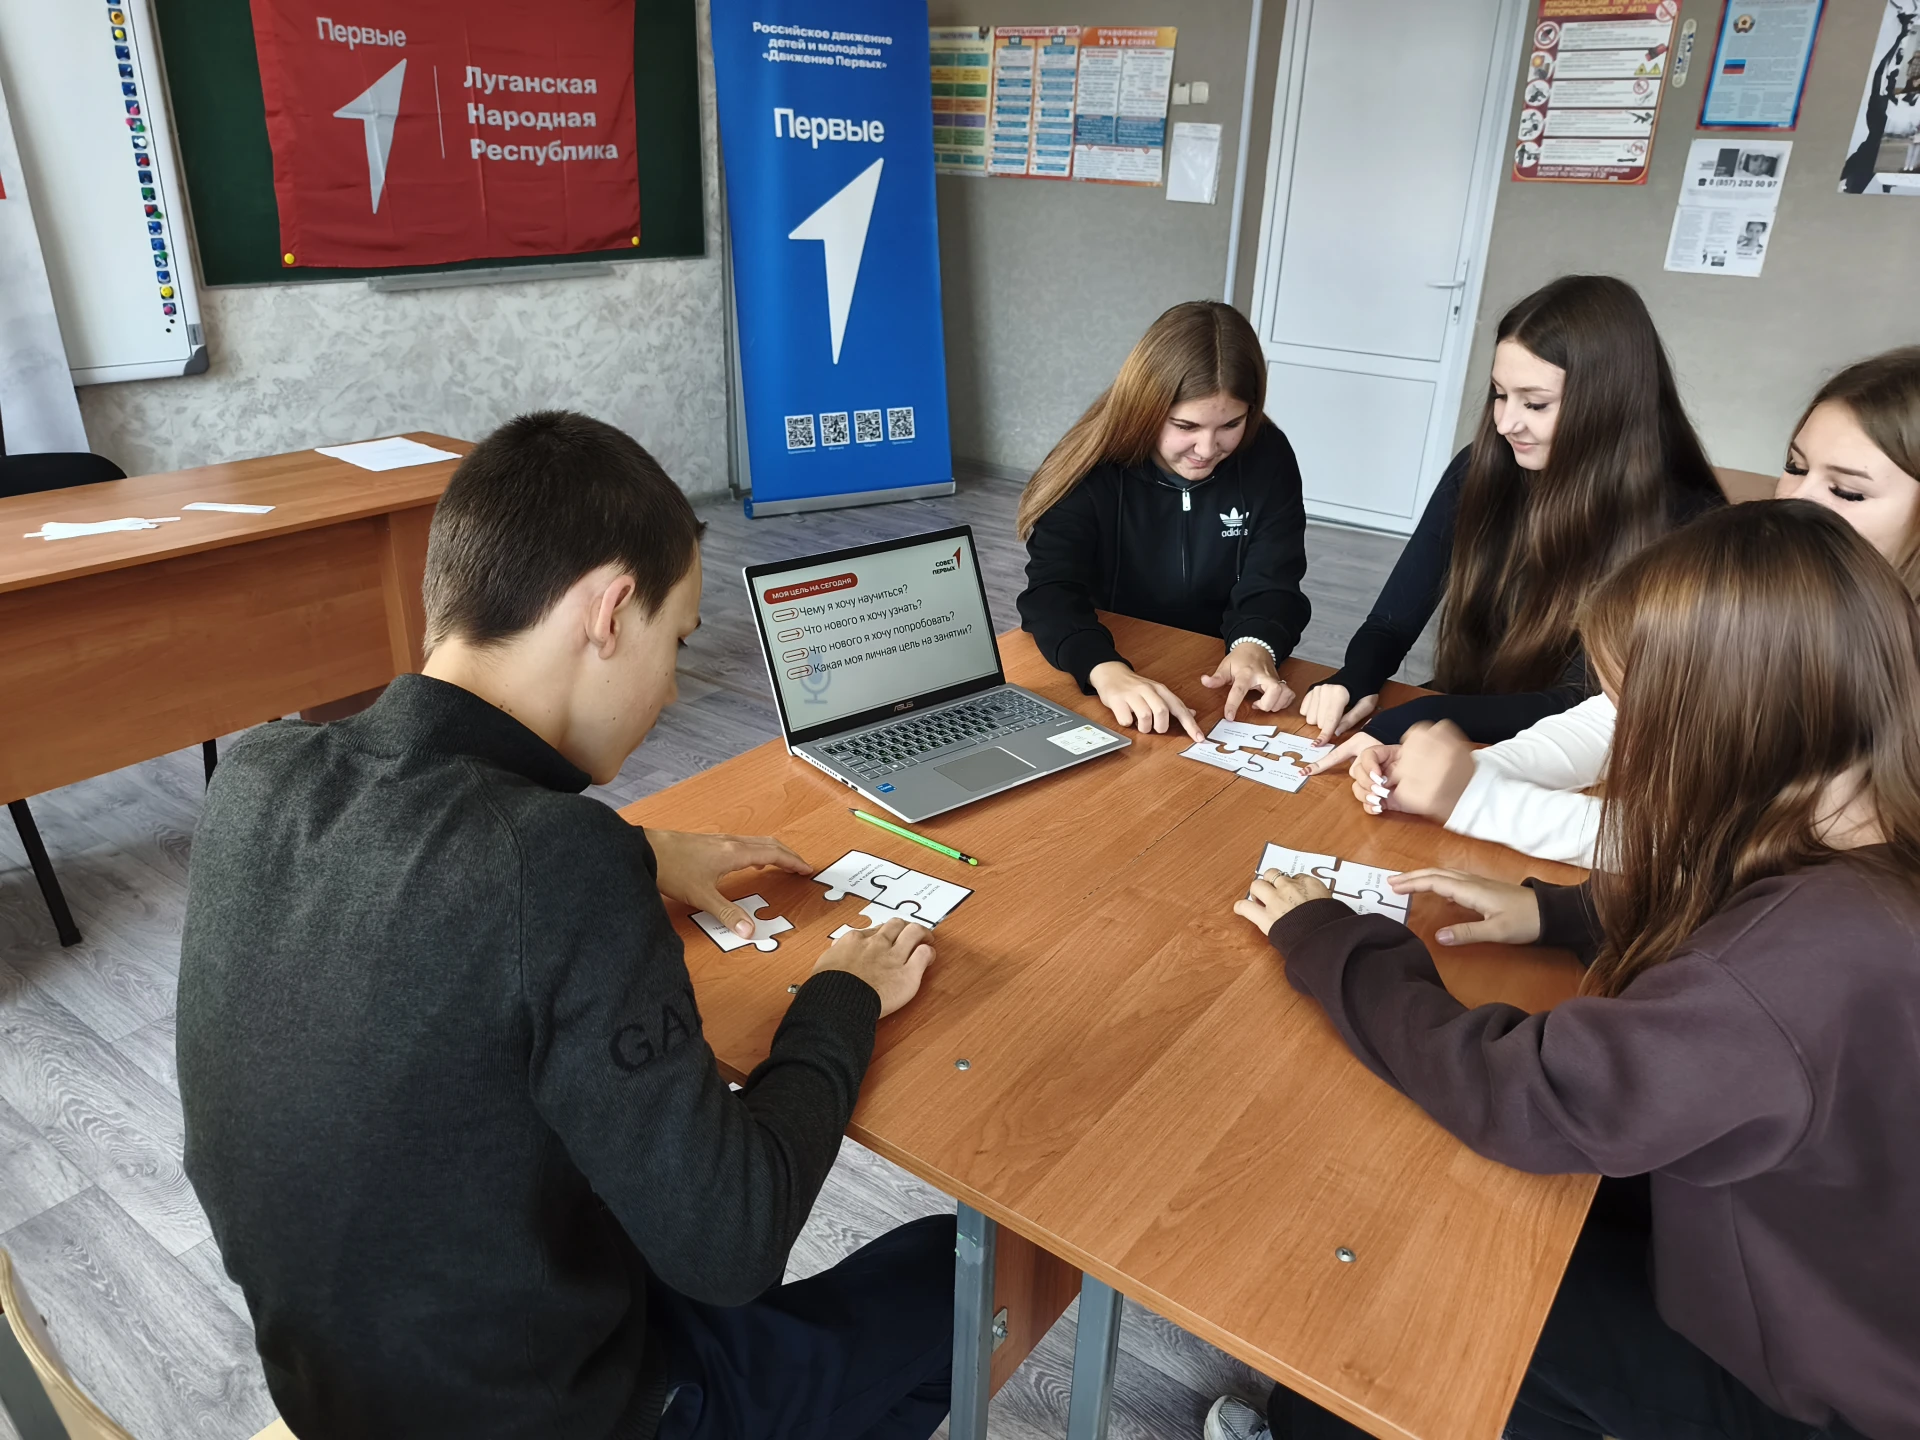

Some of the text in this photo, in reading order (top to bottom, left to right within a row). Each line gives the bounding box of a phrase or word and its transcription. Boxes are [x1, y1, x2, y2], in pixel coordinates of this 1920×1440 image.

[316, 16, 407, 50] Первые
[752, 21, 893, 45] Российское движение
[762, 49, 887, 69] «Движение Первых»
[768, 38, 881, 57] детей и молодёжи
[464, 66, 597, 95] Луганская
[467, 103, 597, 131] Народная
[773, 107, 885, 149] Первые
[470, 138, 619, 166] Республика
[932, 566, 956, 575] ПЕРВЫХ
[935, 559, 954, 567] СОВЕТ
[772, 590, 790, 599] МОЯ
[790, 587, 809, 596] ЦЕЛЬ
[820, 578, 852, 589] СЕГОДНЯ
[798, 584, 908, 616] Чему я хочу научиться?
[803, 599, 922, 635] Что нового я хочу узнать?
[809, 610, 955, 655] Что нового я хочу попробовать?
[813, 624, 972, 674] Какая моя личная цель на занятии?
[893, 700, 914, 712] ASUS
